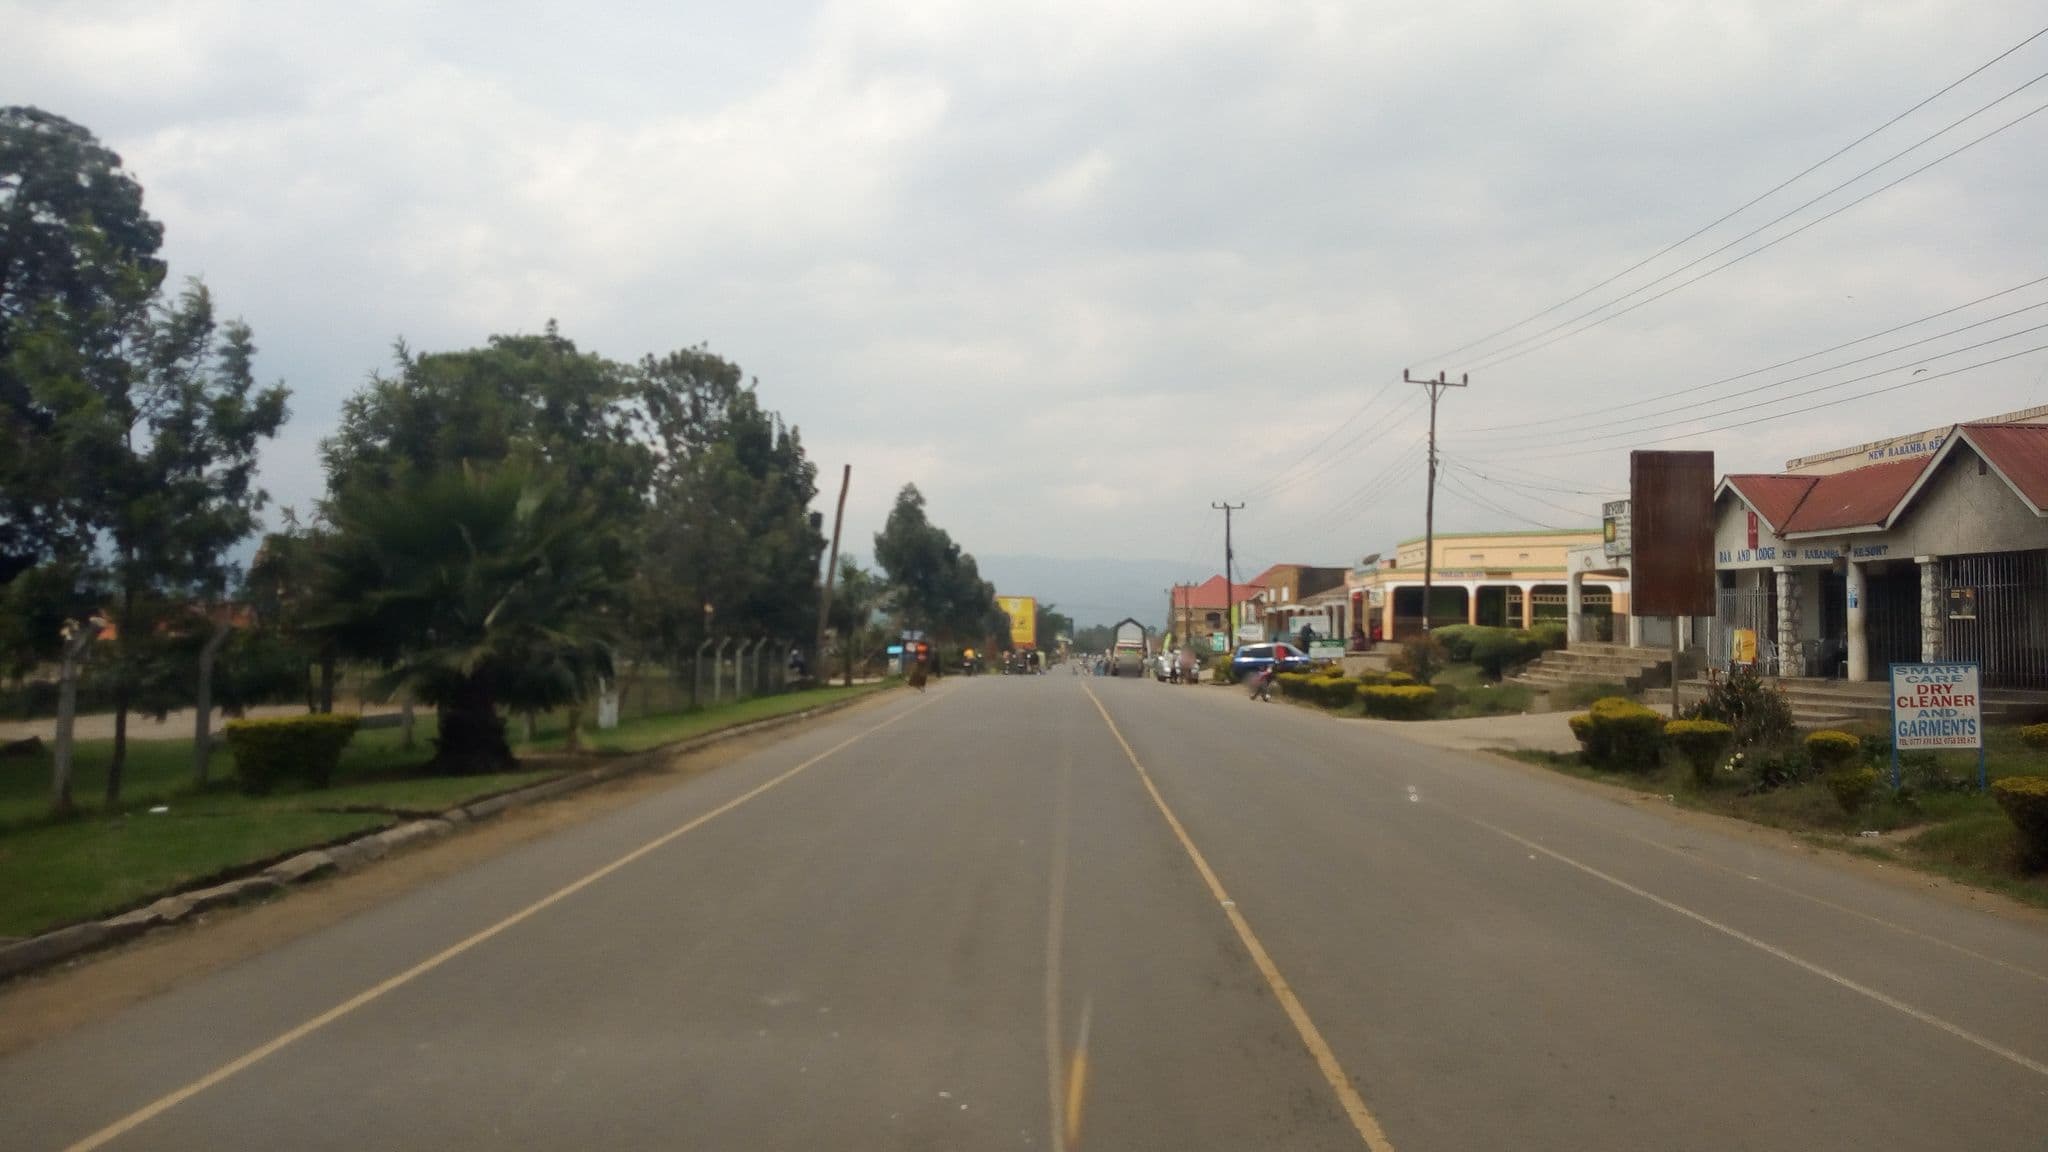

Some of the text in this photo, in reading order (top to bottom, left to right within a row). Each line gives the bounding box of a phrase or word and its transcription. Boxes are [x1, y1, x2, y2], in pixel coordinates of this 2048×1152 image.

[1869, 449, 1885, 460] NEW
[1719, 551, 1732, 562] BAR
[1738, 549, 1750, 561] AND
[1755, 546, 1776, 561] LODGE
[1782, 549, 1796, 558] NEW
[1854, 545, 1889, 557] RESORT
[1896, 666, 1972, 675] SMART
[1905, 675, 1964, 683] CARE
[1918, 684, 1953, 695] DRY
[1897, 695, 1975, 708] CLEANER
[1918, 709, 1958, 718] AND
[1899, 719, 1976, 737] GARMENTS
